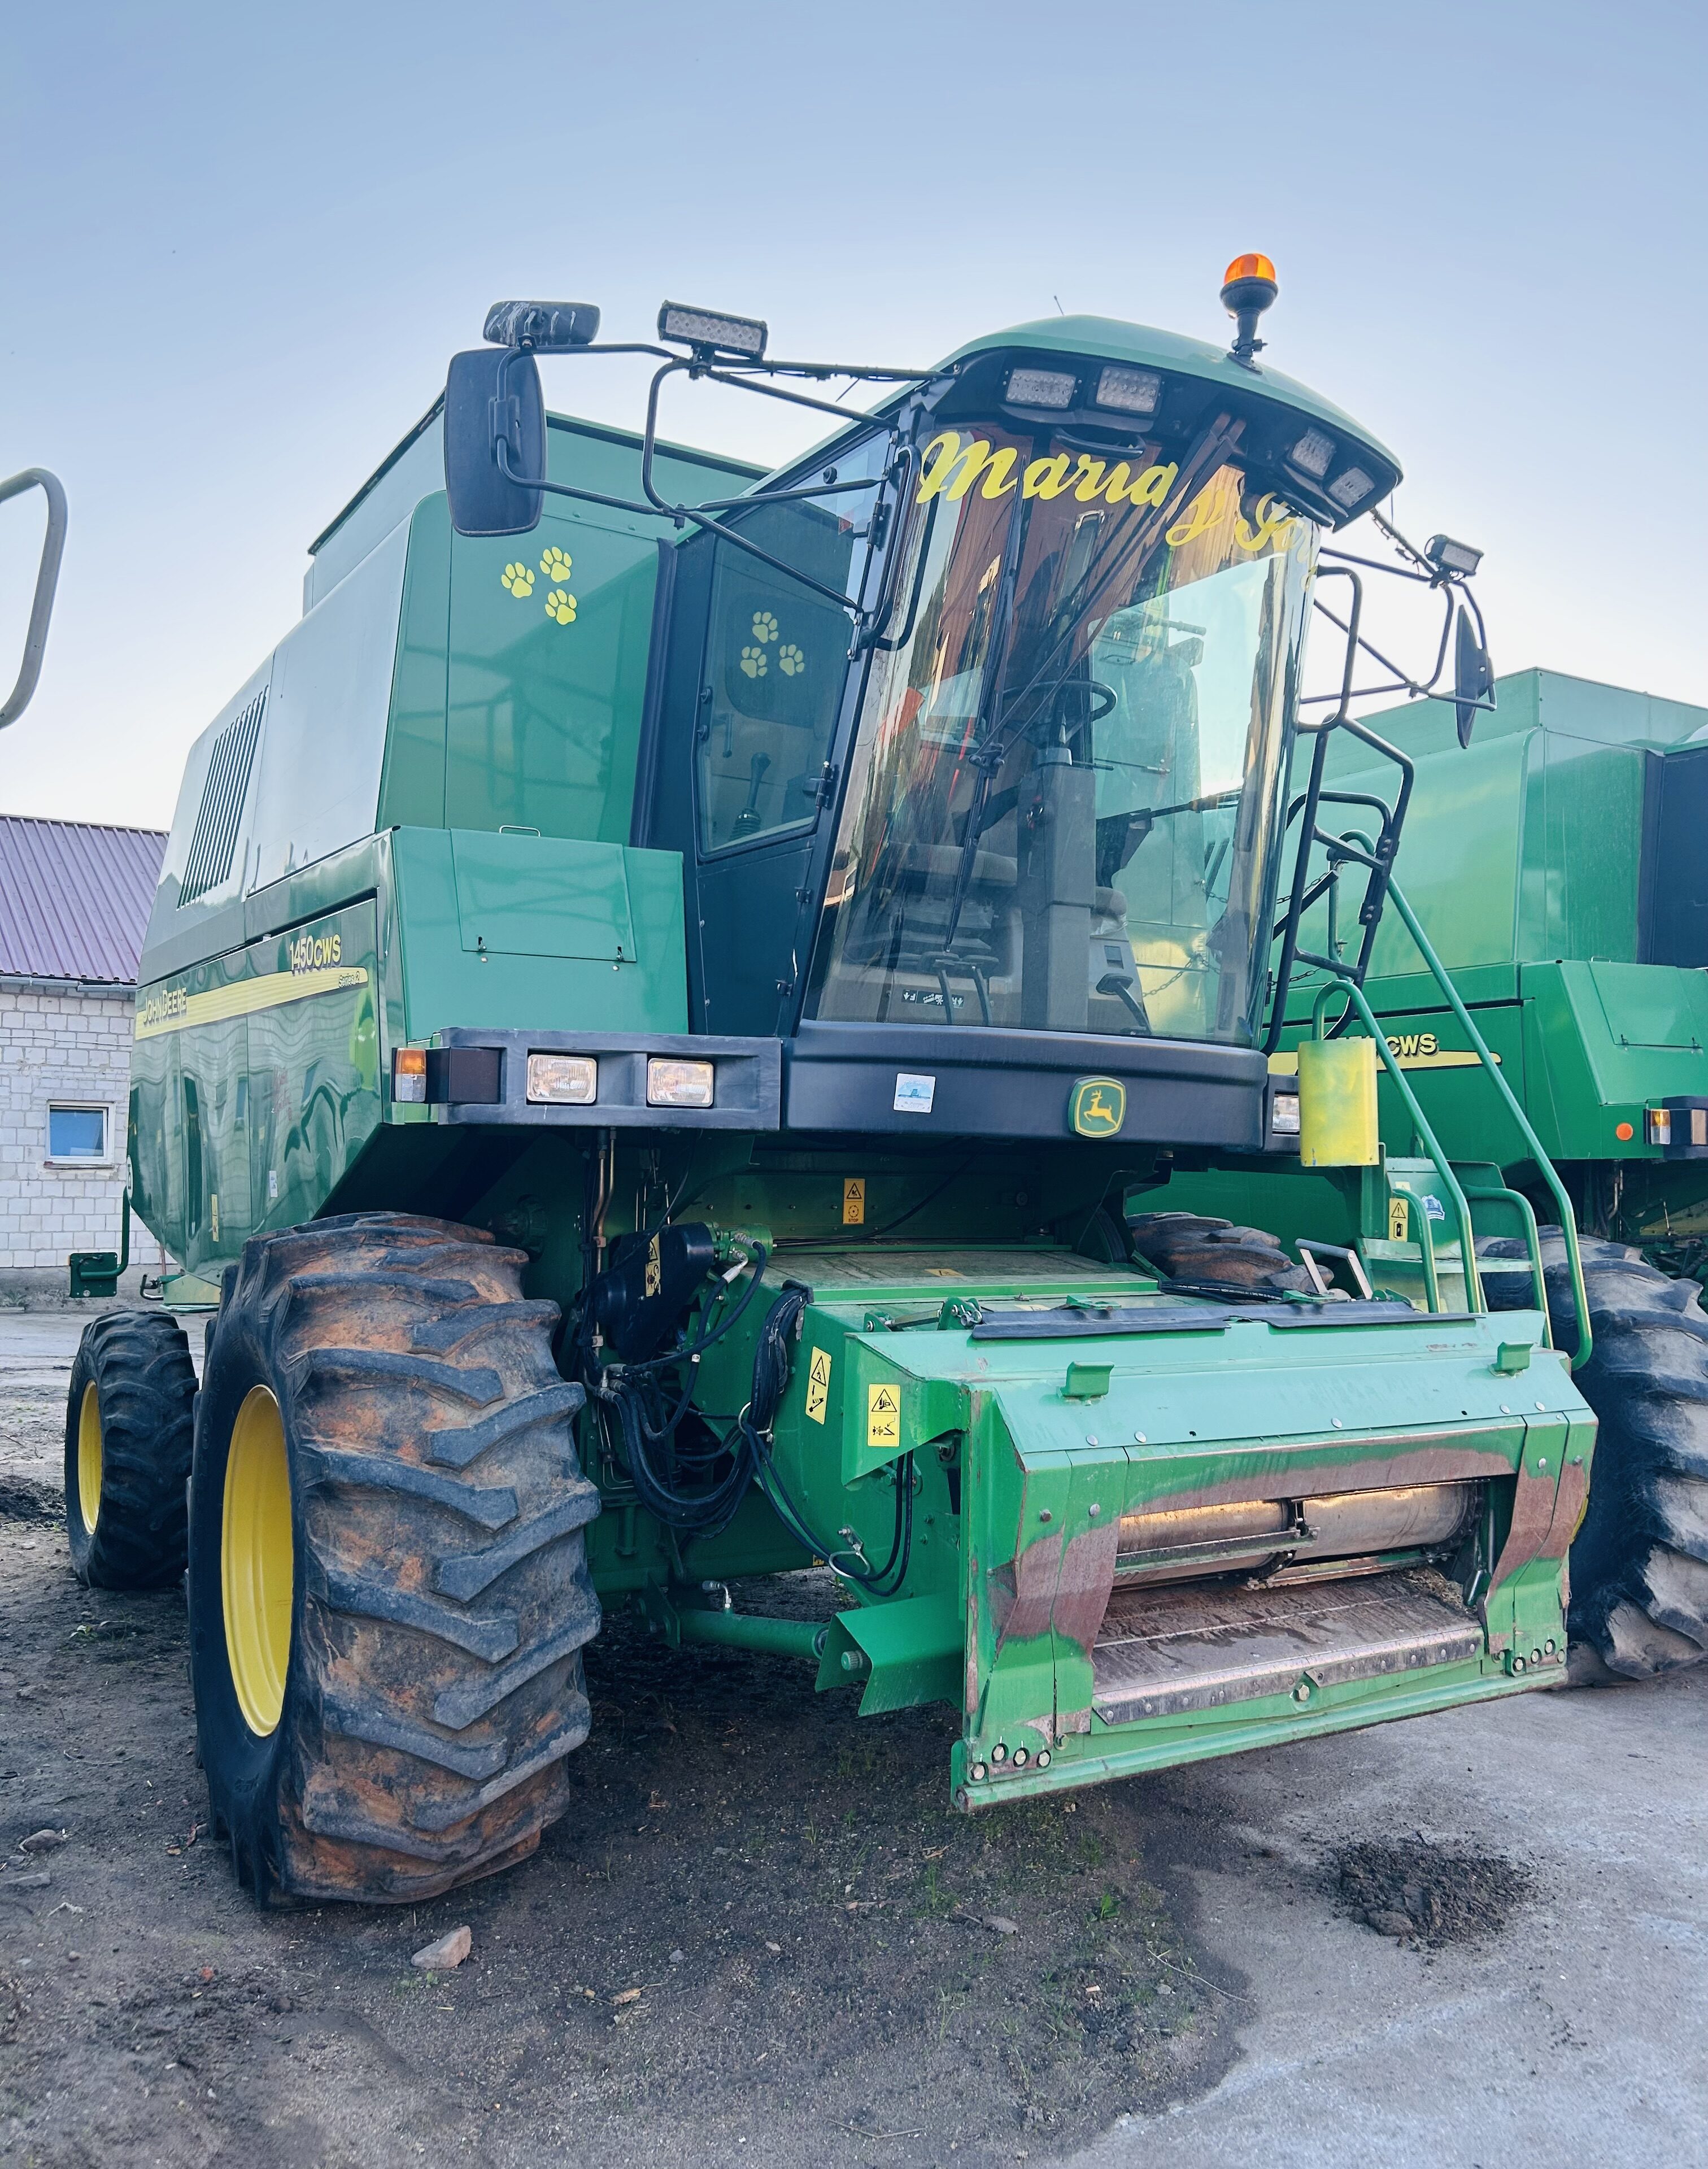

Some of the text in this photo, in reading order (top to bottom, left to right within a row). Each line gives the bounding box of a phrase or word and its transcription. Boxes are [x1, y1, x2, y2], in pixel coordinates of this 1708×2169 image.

[916, 431, 1179, 508] Maria
[339, 970, 360, 988] Series 2
[143, 987, 188, 1025] JOHN DEERE
